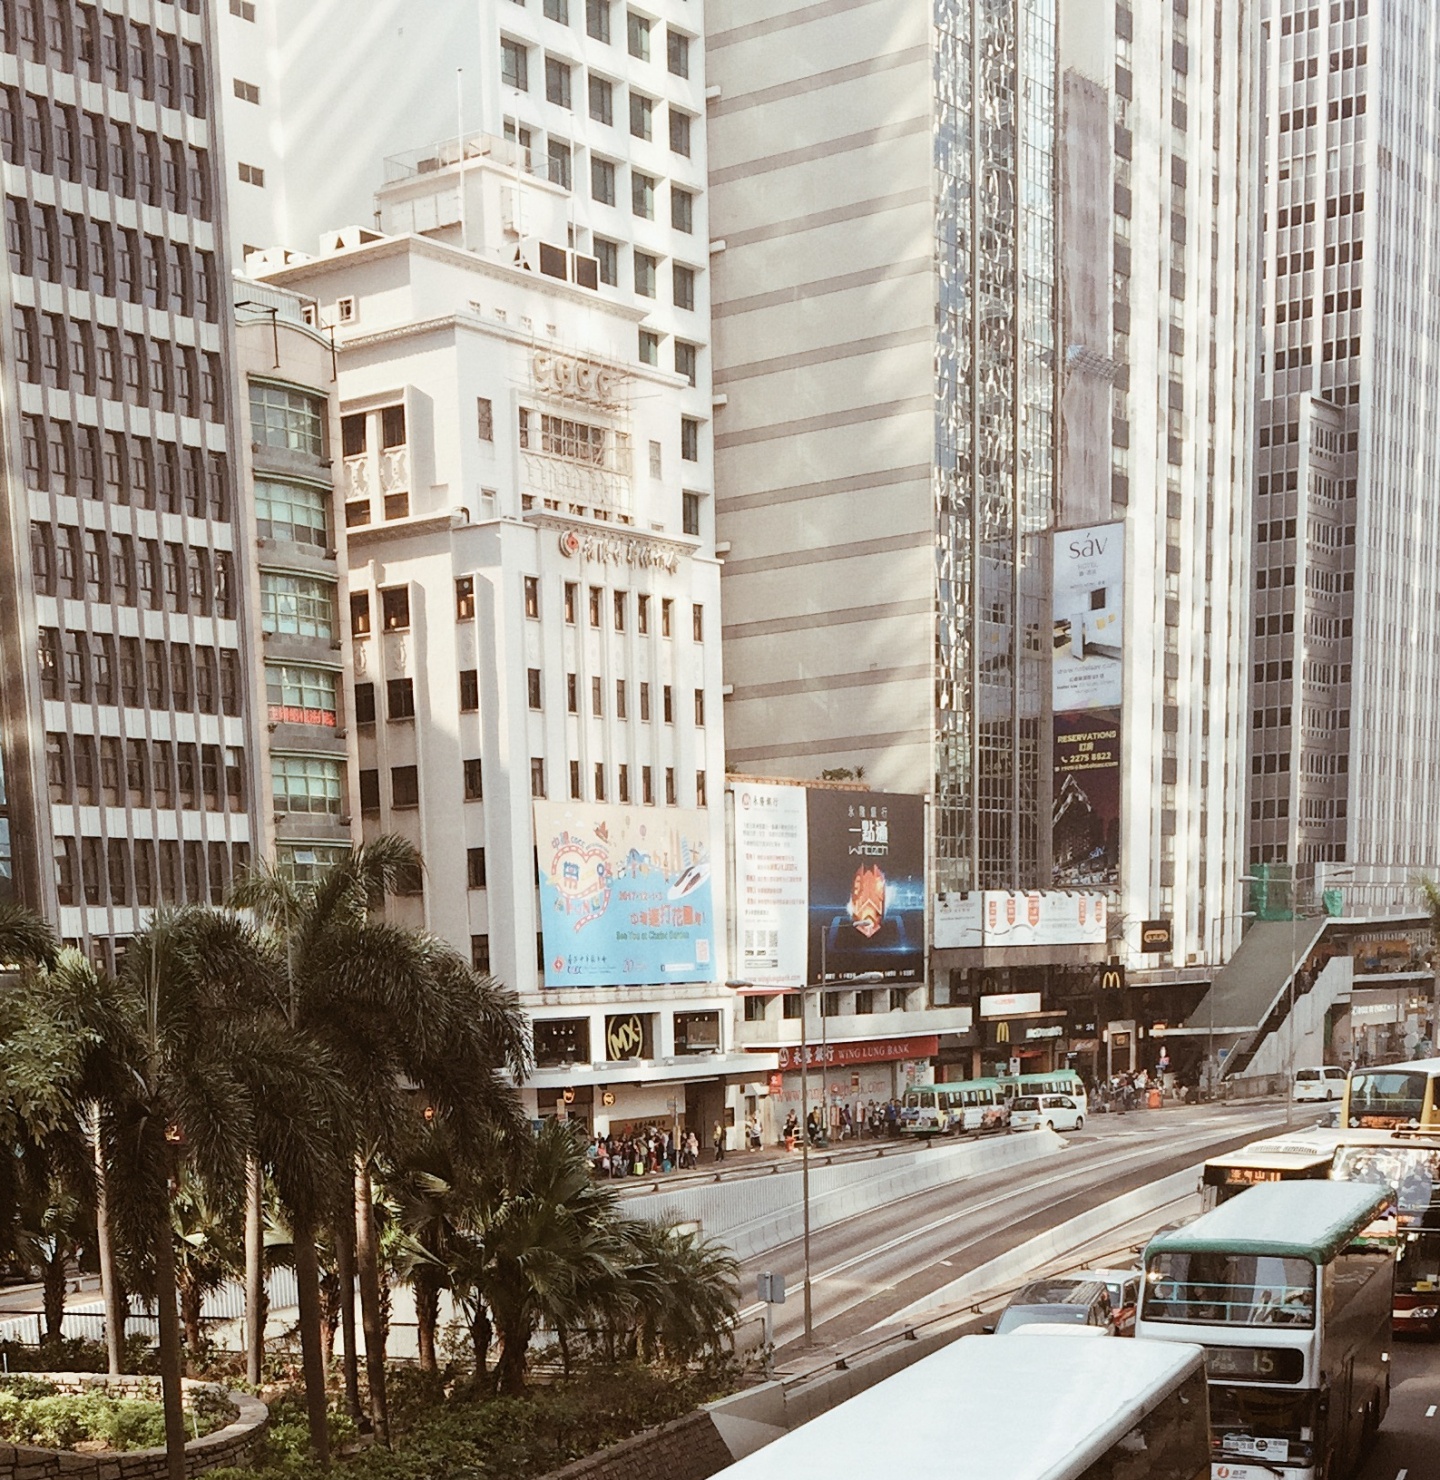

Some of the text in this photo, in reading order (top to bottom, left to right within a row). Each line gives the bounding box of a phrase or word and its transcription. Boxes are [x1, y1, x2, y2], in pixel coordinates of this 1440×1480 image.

[1069, 532, 1107, 559] sáv
[1057, 730, 1117, 743] RESERVATIONS
[611, 1017, 640, 1060] MX
[838, 1050, 861, 1060] WING
[862, 1047, 886, 1058] LUNG
[887, 1044, 910, 1055] BANK
[1252, 1350, 1274, 1373] 15
